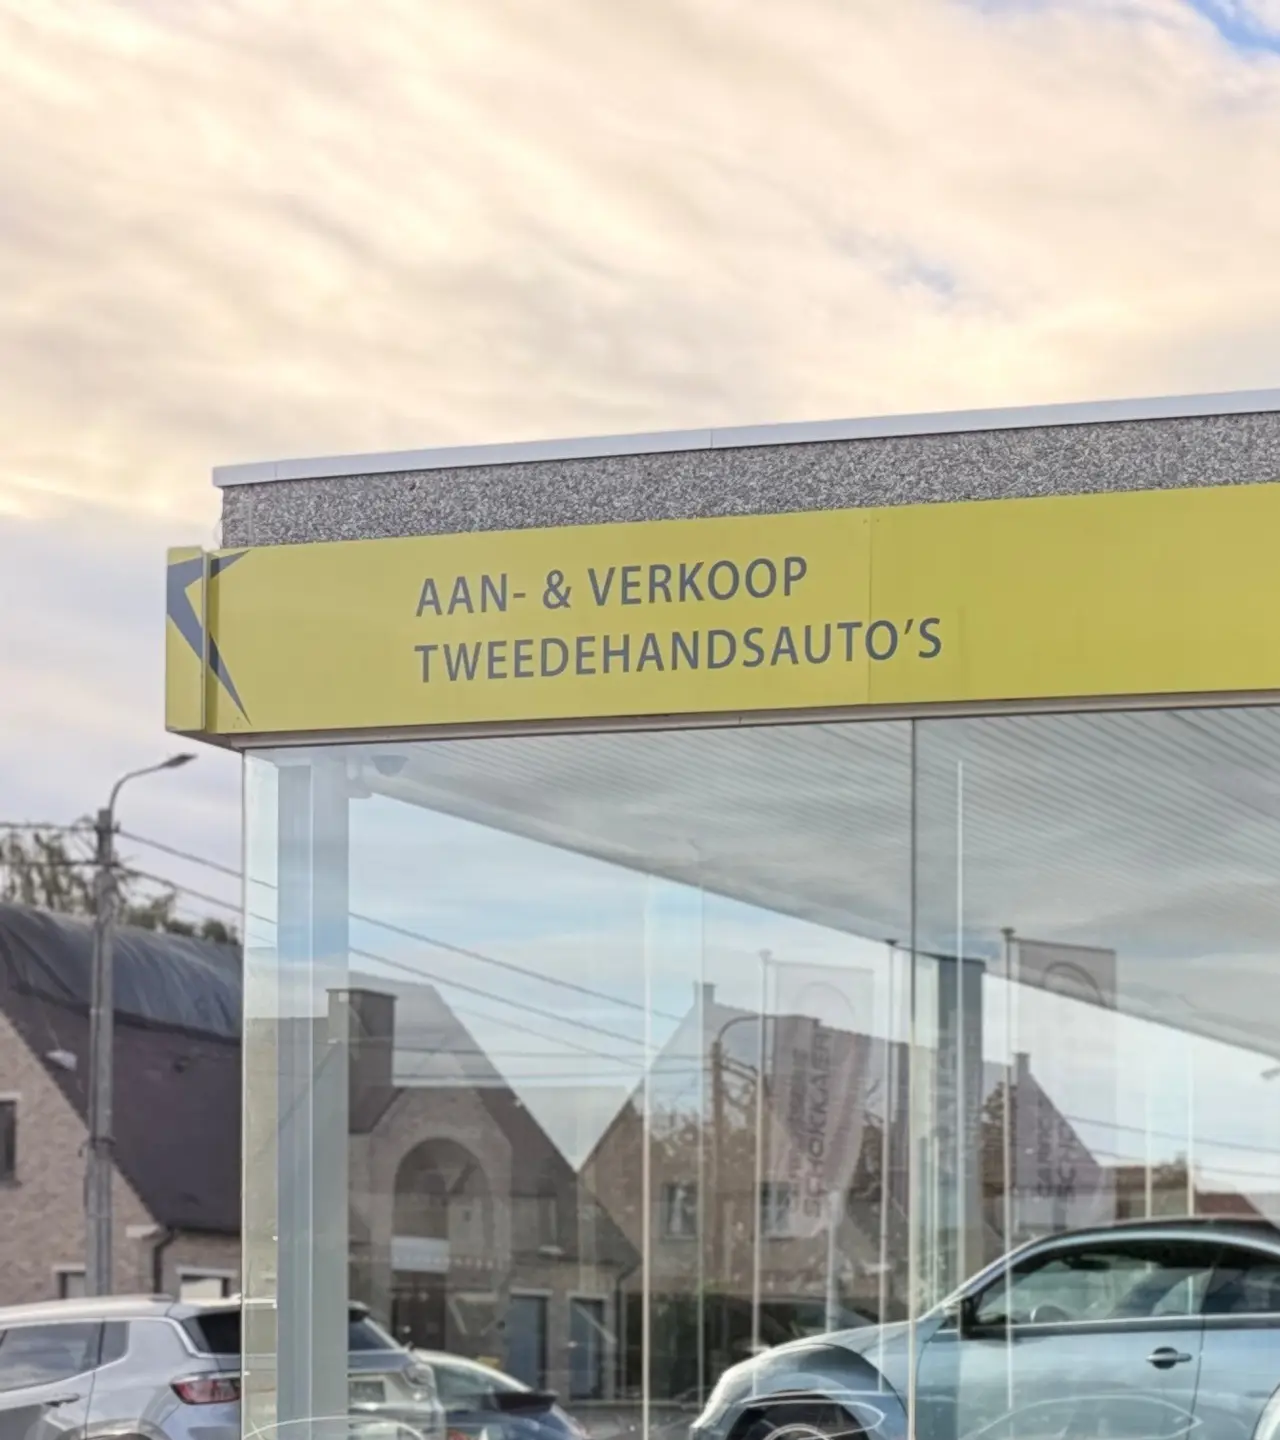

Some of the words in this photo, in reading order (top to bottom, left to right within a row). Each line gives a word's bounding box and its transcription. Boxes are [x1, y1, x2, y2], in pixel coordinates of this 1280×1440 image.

[415, 573, 527, 618] AAN-
[542, 569, 573, 611] &
[588, 555, 809, 607] VERKOOP
[414, 617, 943, 683] TWEEDEHANDSAUTO'S
